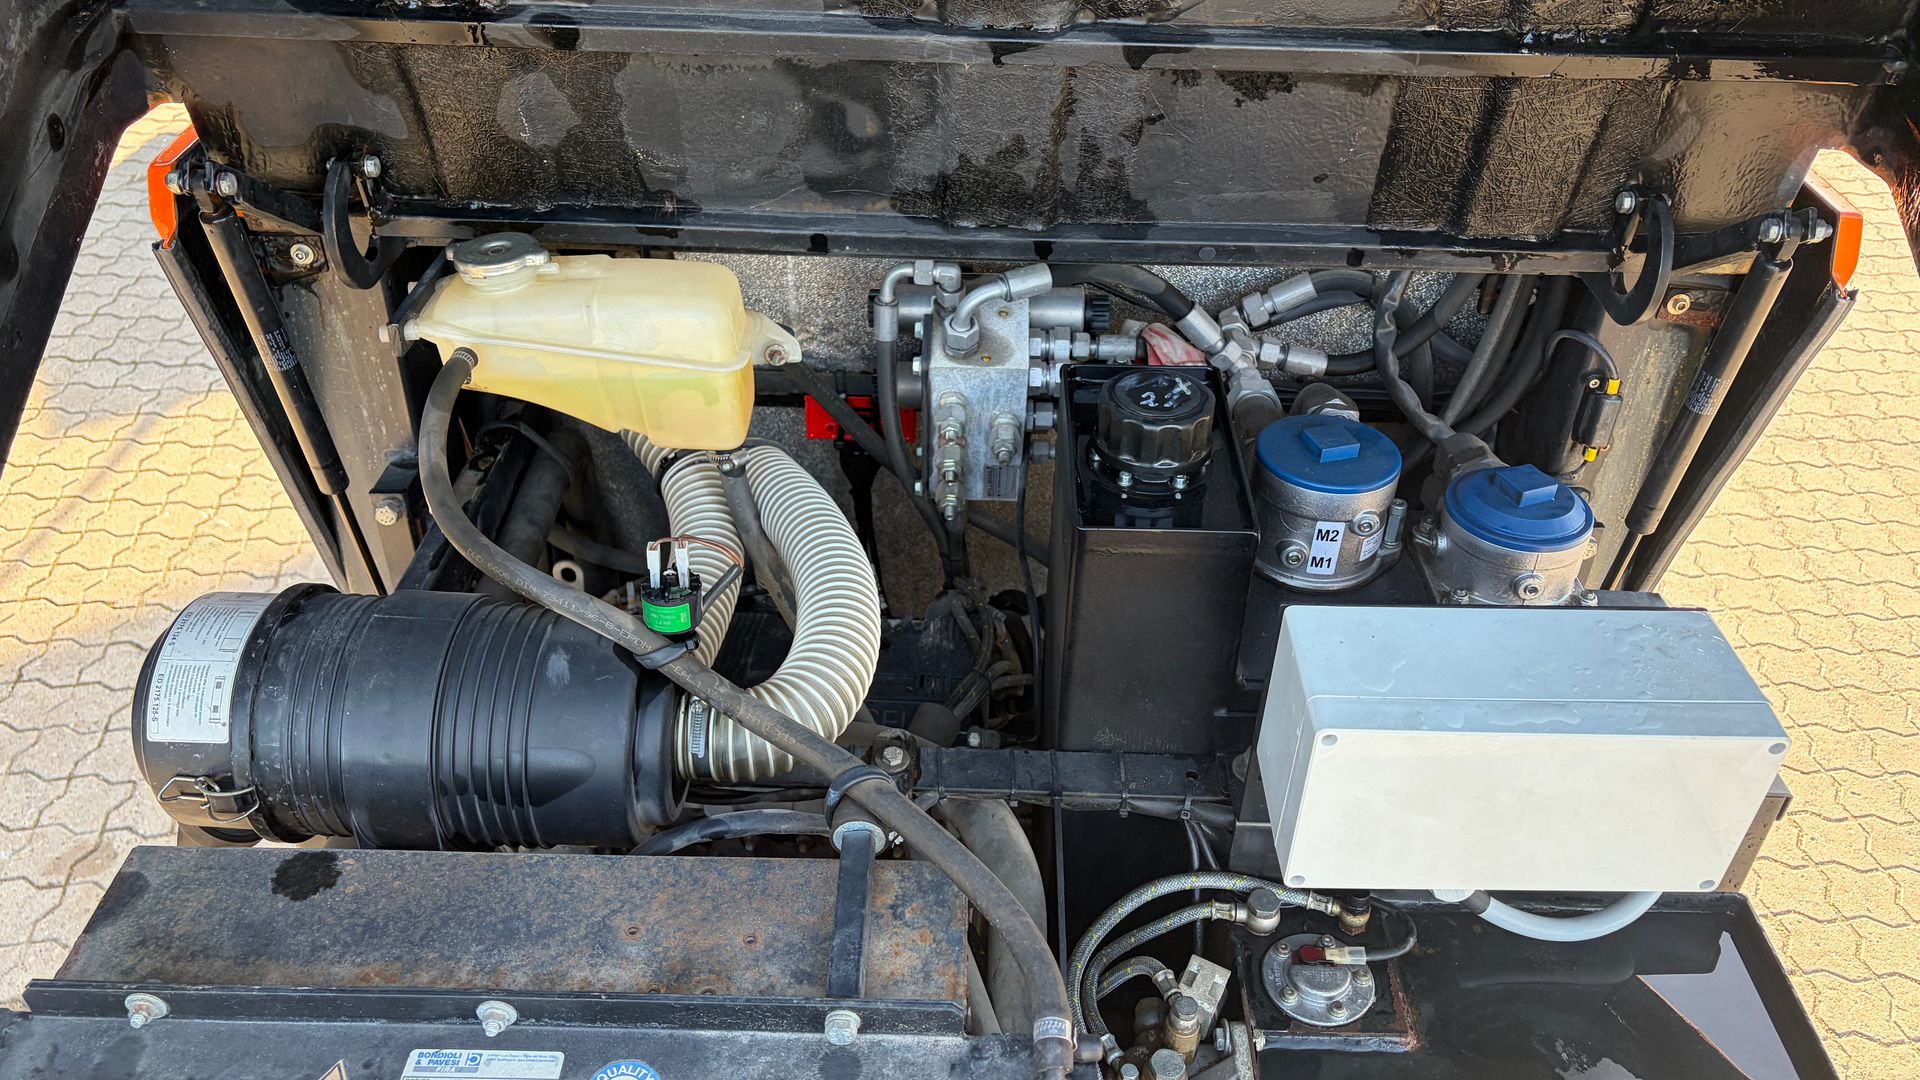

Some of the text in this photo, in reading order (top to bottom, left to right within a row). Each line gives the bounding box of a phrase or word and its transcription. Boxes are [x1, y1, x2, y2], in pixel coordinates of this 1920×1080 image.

[1316, 529, 1339, 542] M2
[1310, 556, 1332, 568] M1
[417, 1051, 462, 1060] BONDIOLI
[427, 1059, 461, 1067] PAVESI
